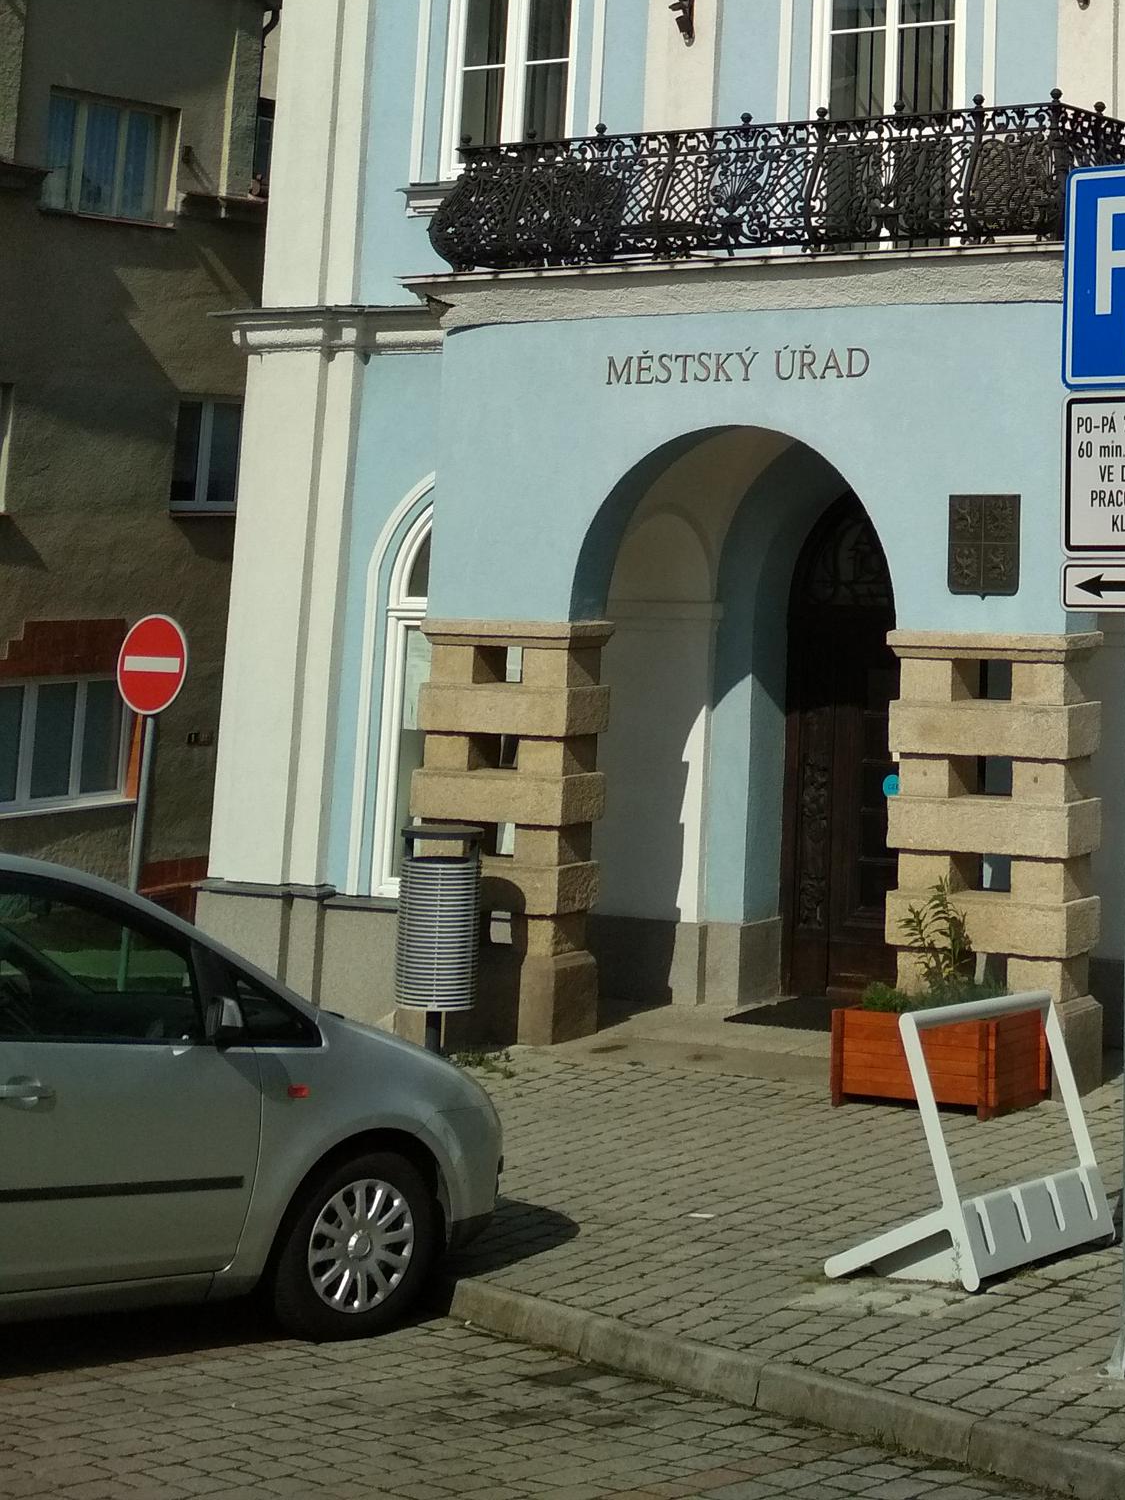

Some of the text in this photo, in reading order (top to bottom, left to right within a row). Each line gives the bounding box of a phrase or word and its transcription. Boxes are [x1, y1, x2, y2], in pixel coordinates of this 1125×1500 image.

[605, 344, 870, 385] MĚSTSKÝ ÚŘAD
[1076, 411, 1117, 434] PO-PÁ
[1077, 440, 1093, 458] 60
[1099, 440, 1125, 458] min.
[1099, 465, 1114, 482] VE
